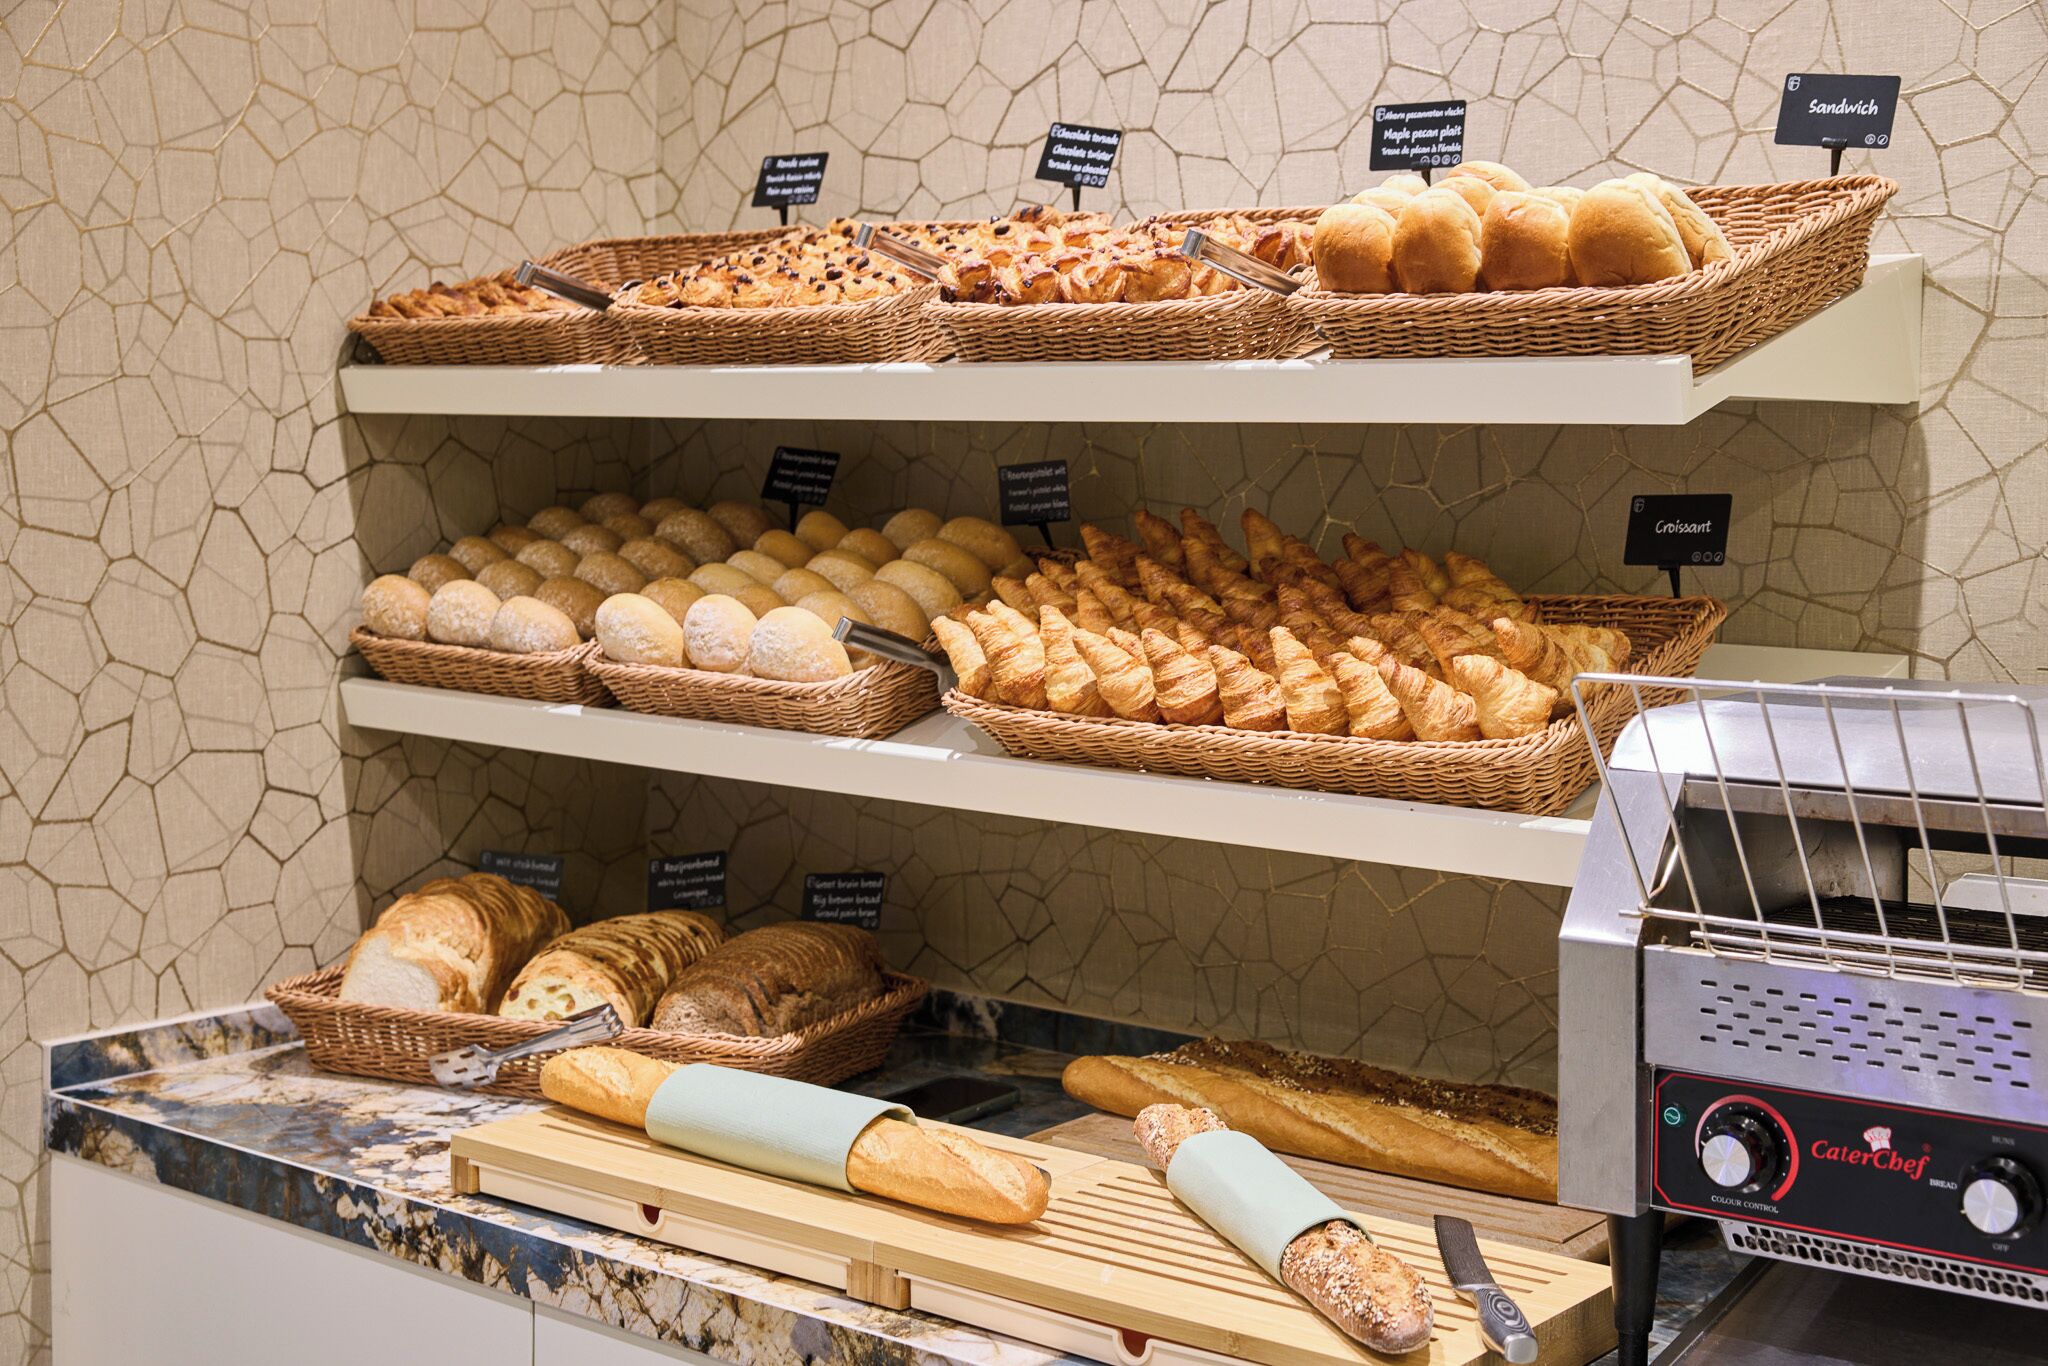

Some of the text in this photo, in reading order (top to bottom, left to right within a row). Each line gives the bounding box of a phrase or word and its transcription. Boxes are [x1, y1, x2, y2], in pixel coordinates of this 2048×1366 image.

[1809, 98, 1879, 115] Sandwich
[1383, 124, 1462, 144] Maple pecan plait
[1401, 145, 1409, 154] de
[1656, 520, 1712, 533] Croissant
[856, 893, 881, 903] bread
[1811, 1140, 1931, 1180] CaterChef
[1929, 1178, 1957, 1190] BREAD
[1711, 1195, 1778, 1214] COLOUR CONTROL
